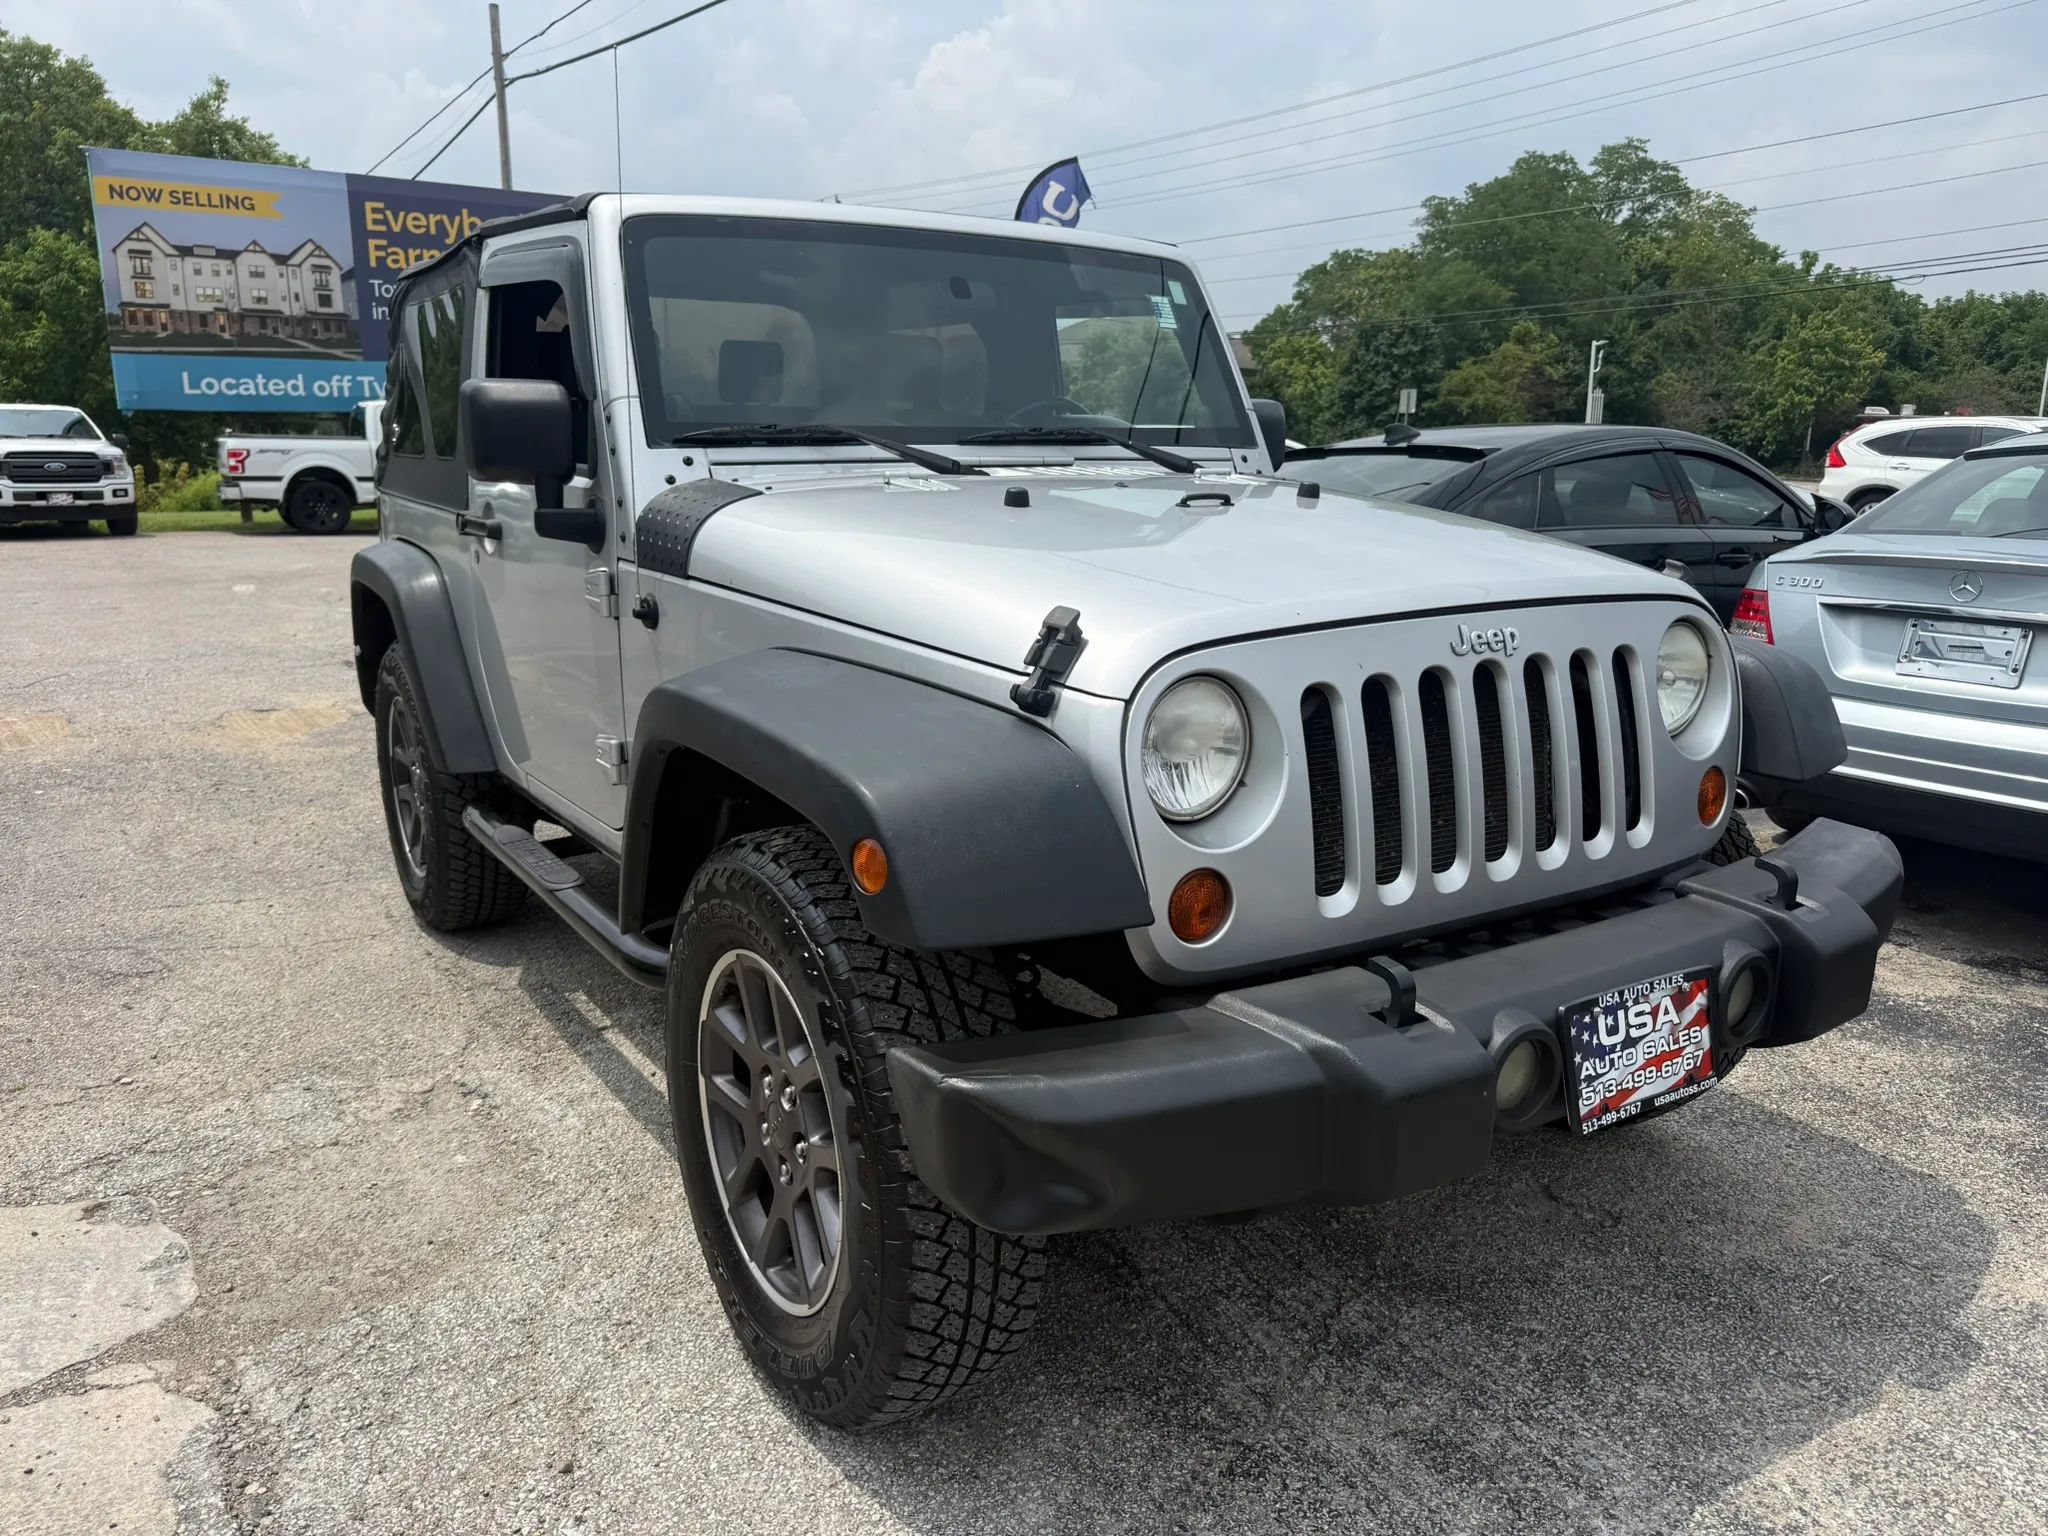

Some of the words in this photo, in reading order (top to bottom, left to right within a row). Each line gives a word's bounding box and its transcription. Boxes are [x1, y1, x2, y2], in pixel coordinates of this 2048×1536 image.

[108, 184, 163, 204] NOW
[168, 190, 256, 211] SELLING
[369, 280, 397, 298] To
[181, 371, 306, 397] Located
[313, 375, 352, 398] off
[1775, 575, 1786, 586] C
[1788, 576, 1824, 589] 300
[1449, 623, 1520, 657] Jeep
[1599, 991, 1620, 1008] USA
[1622, 983, 1650, 1001] AUTO
[1653, 973, 1684, 992] SALES
[1597, 995, 1680, 1046] USA
[1579, 1047, 1637, 1079] AUTO
[1643, 1025, 1703, 1059] SALES
[1582, 1102, 1642, 1135] 513-499-6767
[1654, 1076, 1718, 1106] usaautoss.com
